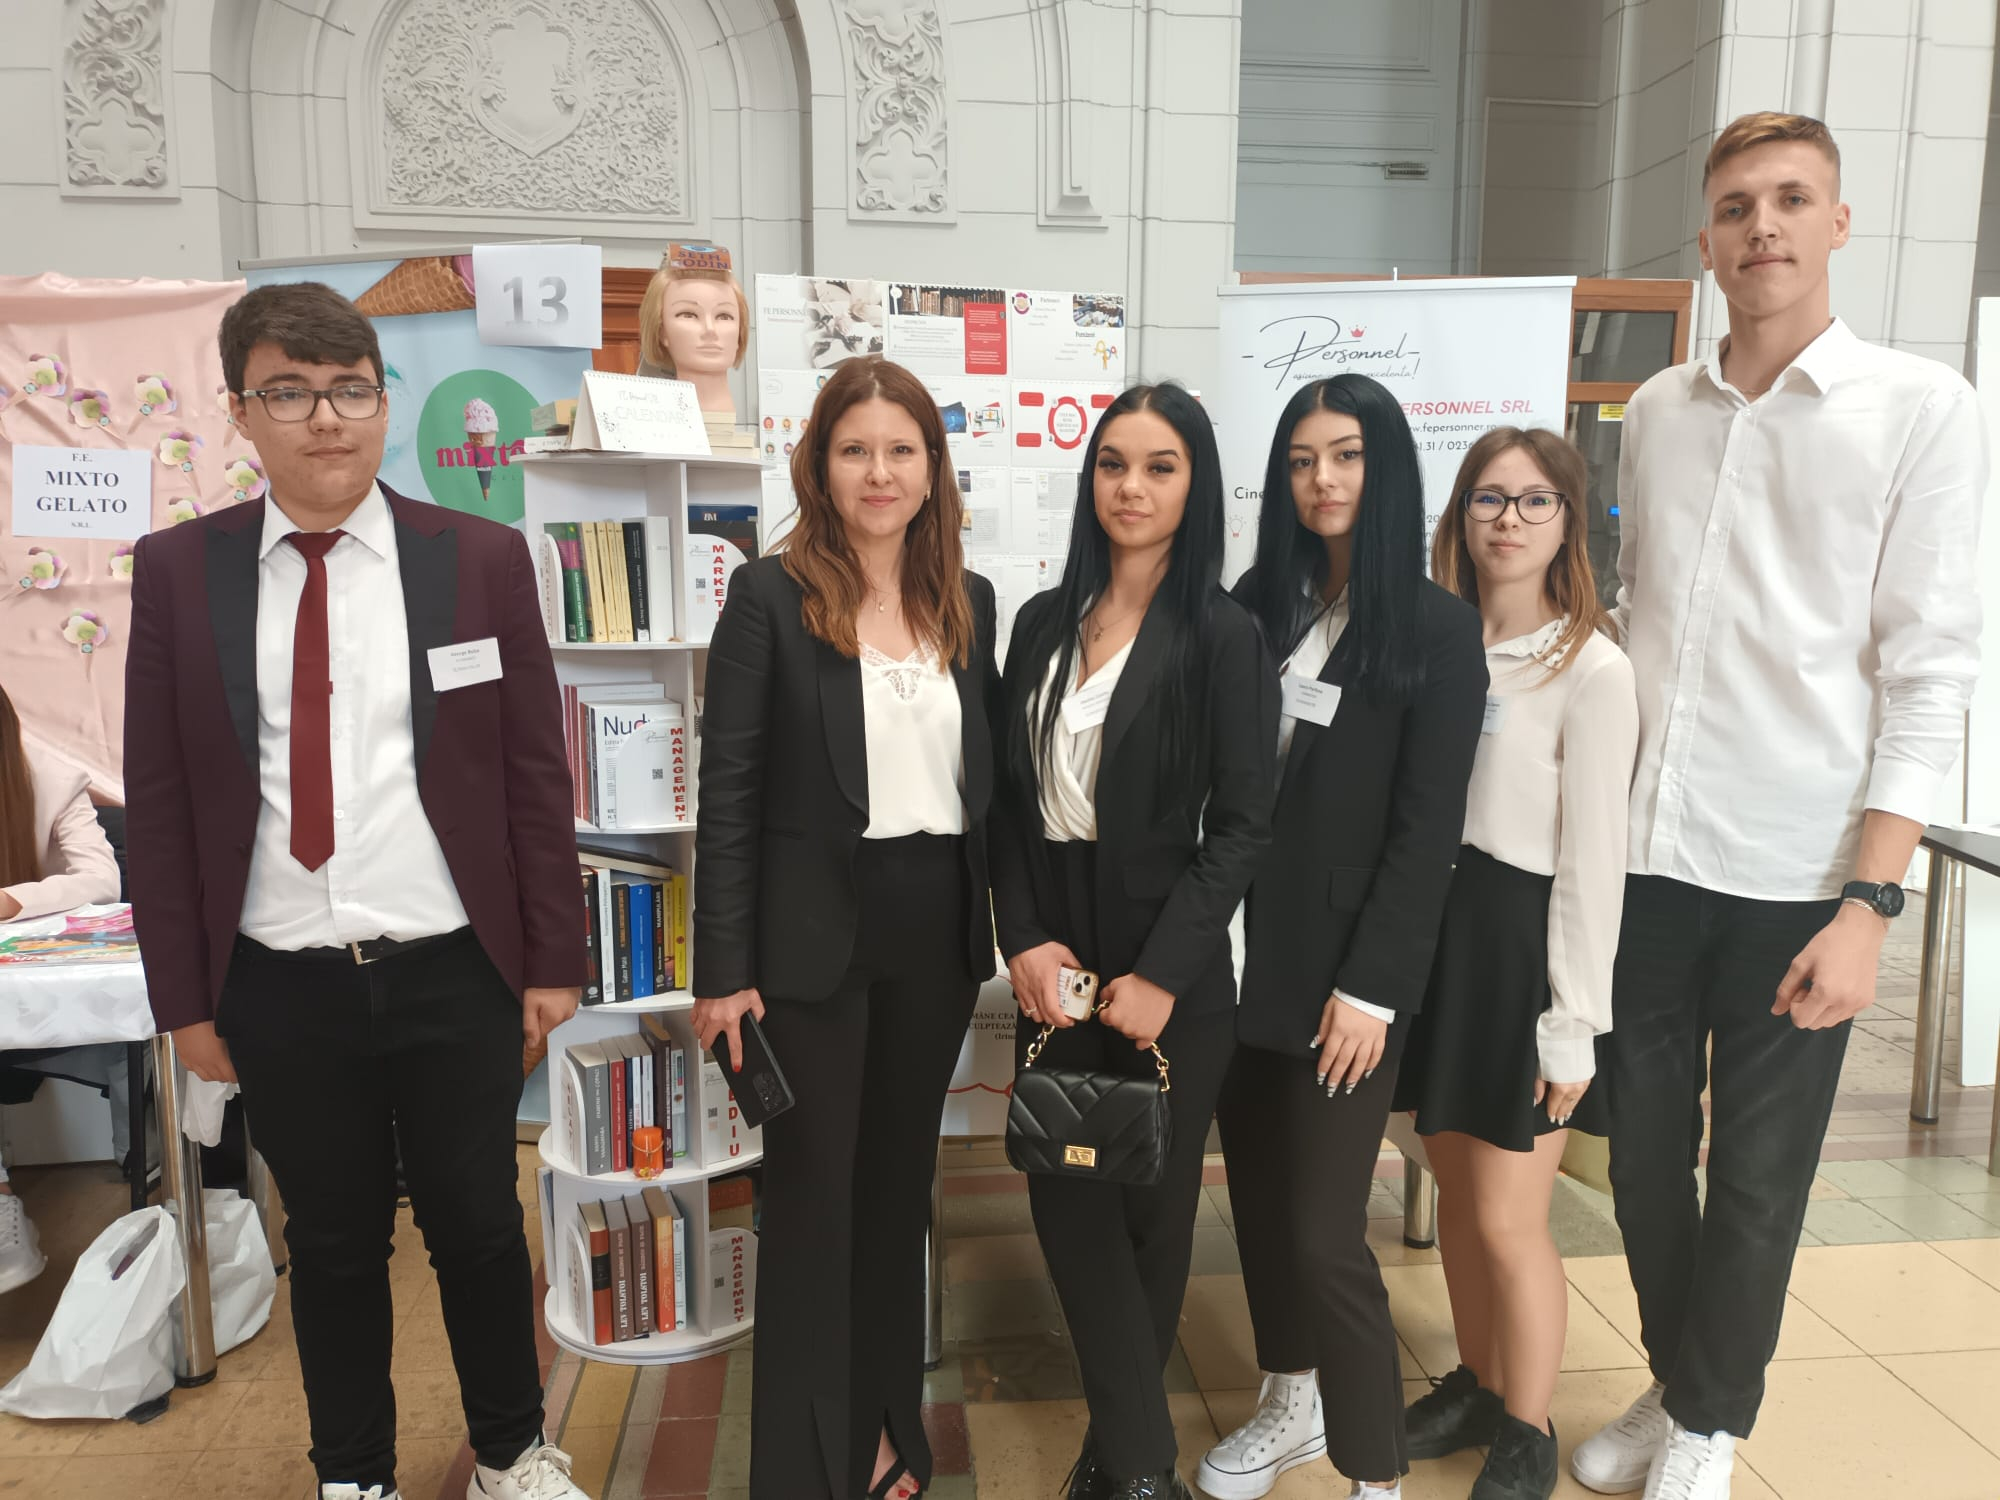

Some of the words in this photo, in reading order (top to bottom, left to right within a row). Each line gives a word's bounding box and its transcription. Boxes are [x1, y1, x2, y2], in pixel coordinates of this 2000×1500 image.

[679, 251, 720, 261] SETH
[683, 258, 728, 270] ODIN
[503, 276, 569, 325] 13
[1259, 315, 1410, 391] Personnel
[1401, 400, 1494, 416] ERSONNEL
[1500, 399, 1534, 414] SRL
[72, 453, 93, 462] F.E.
[45, 470, 119, 488] MIXTO
[36, 496, 127, 514] GELATO
[603, 712, 648, 737] Nud
[670, 728, 686, 822] MANAGEMENT
[998, 1012, 1015, 1020] CEA
[728, 1089, 740, 1156] EDIU
[639, 1272, 648, 1304] TOLSTOI
[731, 1236, 744, 1322] MANAGEMENT
[618, 1279, 627, 1312] TOLSTOI
[620, 1313, 628, 1328] LEV
